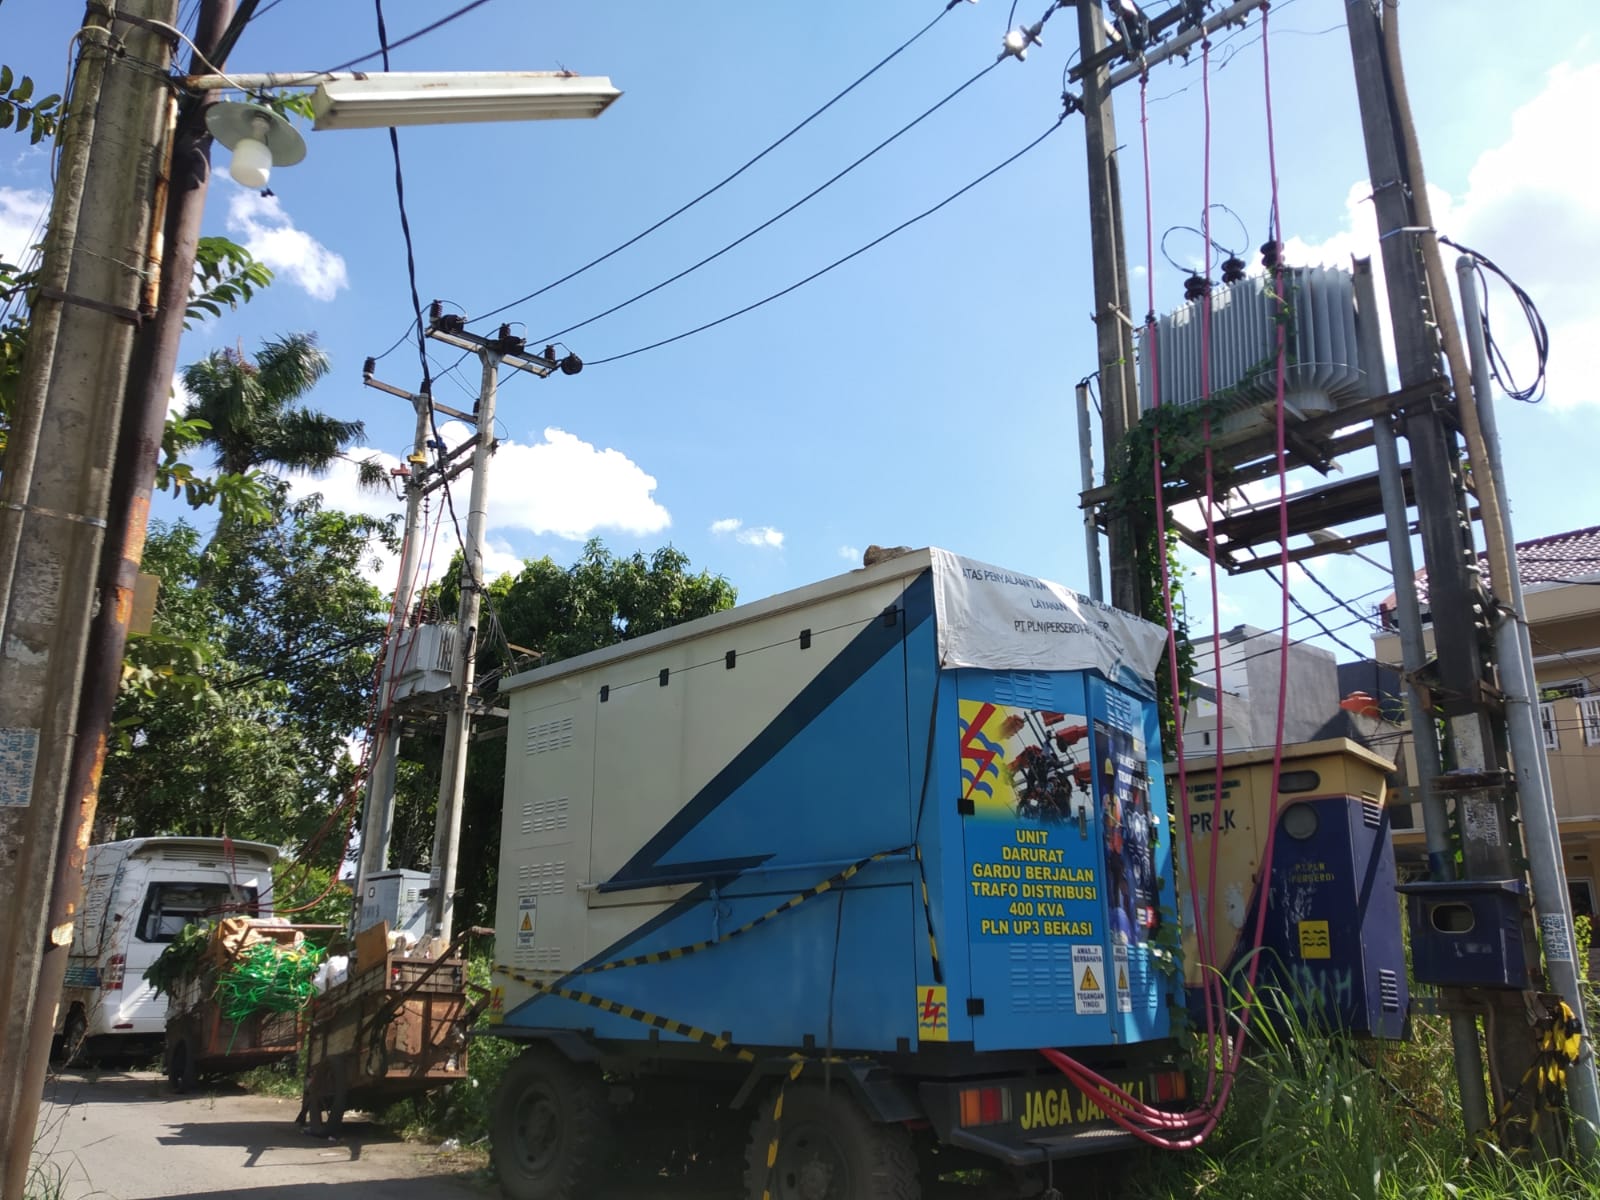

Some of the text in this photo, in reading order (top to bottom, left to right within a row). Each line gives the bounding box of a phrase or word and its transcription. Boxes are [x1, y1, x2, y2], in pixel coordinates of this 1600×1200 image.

[1016, 830, 1048, 845] UNIT
[1002, 846, 1065, 864] DARURAT
[972, 863, 1095, 882] GARDU BERJALAN
[971, 881, 1097, 900] TRAFO DISTRIBUSI
[1009, 902, 1065, 917] 400 KVA
[981, 920, 1093, 937] PLN UP3 BEKASI
[1020, 1088, 1073, 1130] JAGA
